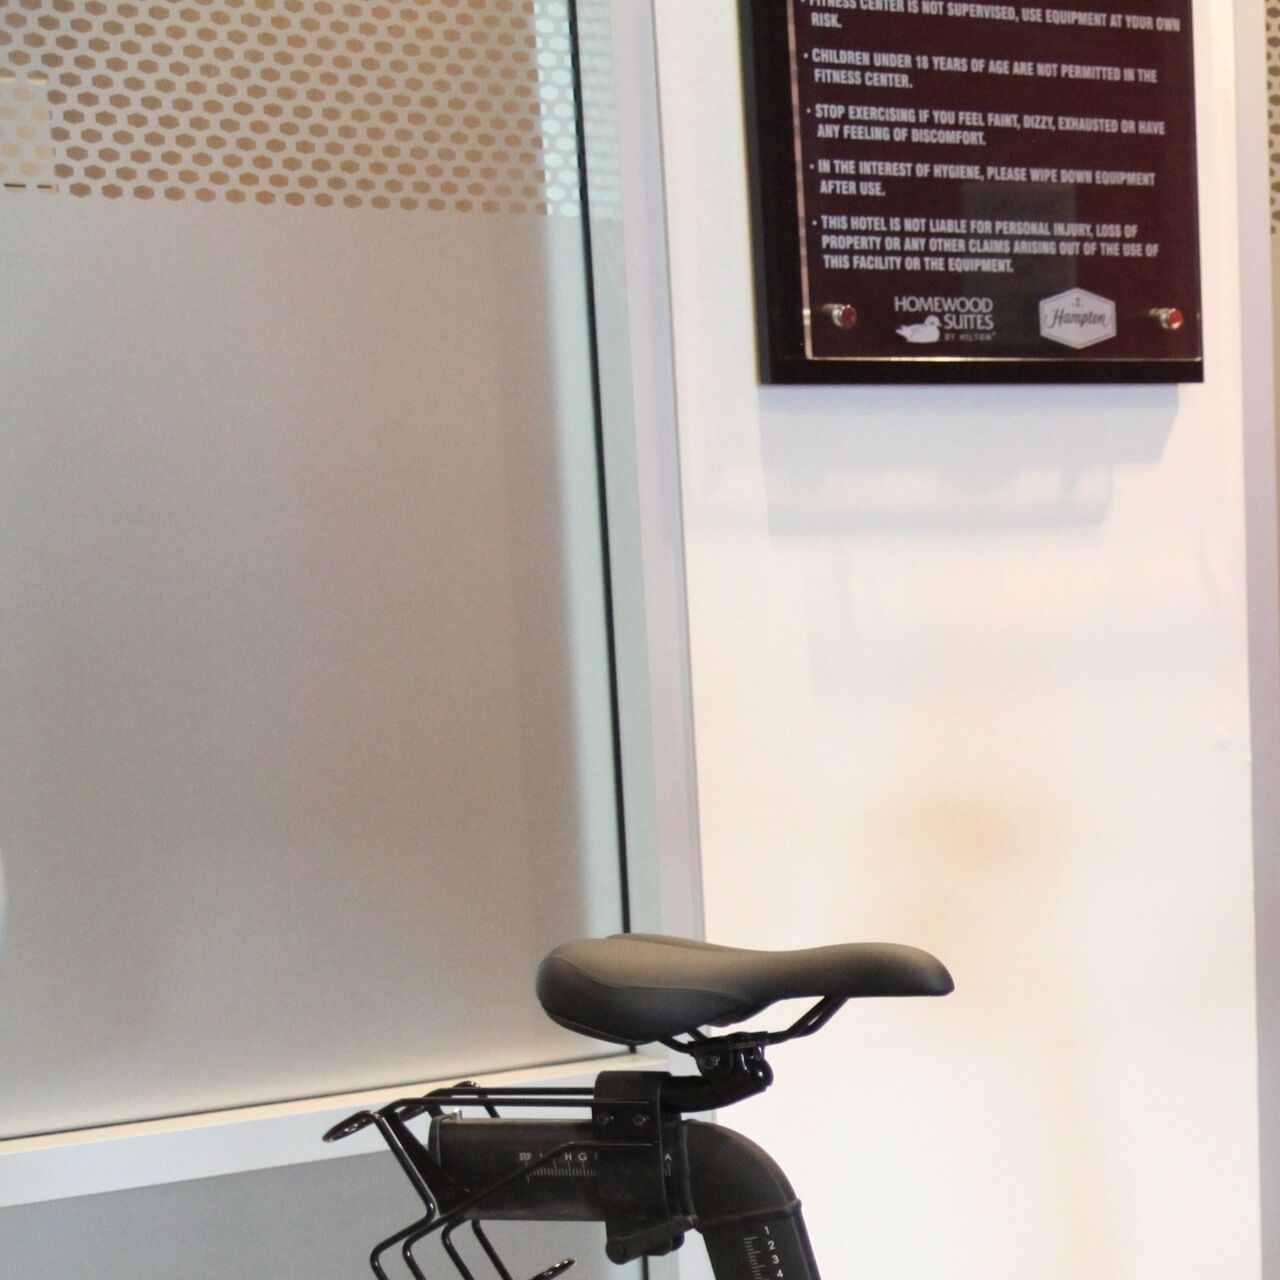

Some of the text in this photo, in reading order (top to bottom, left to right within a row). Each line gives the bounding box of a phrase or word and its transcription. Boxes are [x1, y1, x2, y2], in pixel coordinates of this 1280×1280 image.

[811, 12, 842, 28] RISK.
[860, 0, 904, 12] CENTER
[908, 0, 919, 14] IS
[922, 1, 944, 15] NOT
[948, 2, 1019, 22] SUPERVISED,
[1021, 8, 1042, 22] USE
[1046, 9, 1107, 26] EQUIPMENT
[1110, 14, 1123, 27] AT
[1125, 15, 1153, 30] YOUR
[1156, 16, 1180, 32] OWN
[812, 48, 1157, 82] CHILDREN UNDER 18 YEARS OF AGE ARE NOT PERMITTED IN THE
[814, 68, 913, 88] FITNESS CENTER.
[815, 104, 1165, 135] STOP EXERCISING IF YOU FEEL FAINT, DIZZY, EXHAUSTED OR HAVE
[817, 124, 986, 145] ANY FEELING OF DISCOMFORT.
[818, 159, 1155, 186] IN THE INTEREST OF HYGIENE, PLEASE WIPE DOWN EQUIPMENT
[820, 180, 886, 196] AFTER USE.
[821, 215, 1138, 238] THIS HOTEL IS NOT LIABLE FOR PERSONAL INJURY, LOSS OF
[822, 234, 1159, 257] PROPERTY OR ANY OTHER CLAIMS ARISING OUT OF THE USE OF
[824, 254, 1014, 273] THIS FACILITY OR THE EQUIPMENT.
[894, 296, 994, 313] HOMEWOOD
[944, 314, 994, 330] SUITES
[1050, 308, 1107, 328] Hampton
[565, 1152, 672, 1160] H G A
